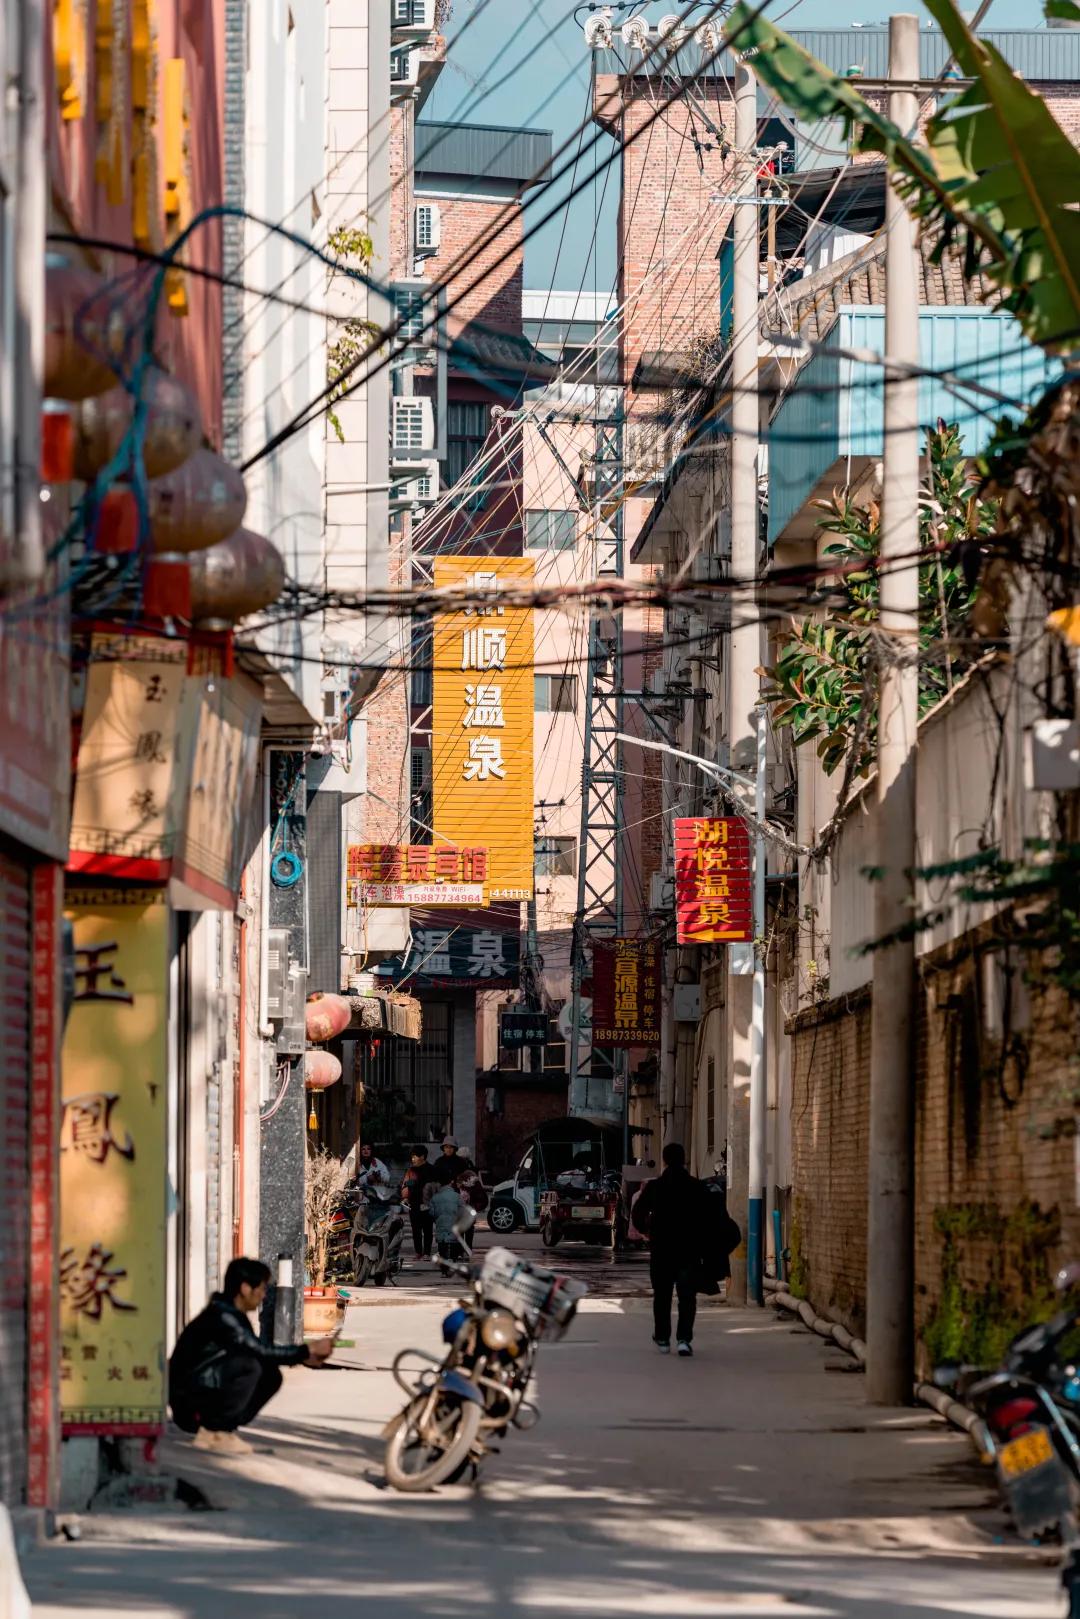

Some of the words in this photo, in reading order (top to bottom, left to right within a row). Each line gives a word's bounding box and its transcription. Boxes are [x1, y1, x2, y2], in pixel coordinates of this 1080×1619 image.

[693, 820, 733, 926] 湖悦温泉
[408, 893, 481, 903] 15887734964
[595, 1029, 660, 1041] 18987339620
